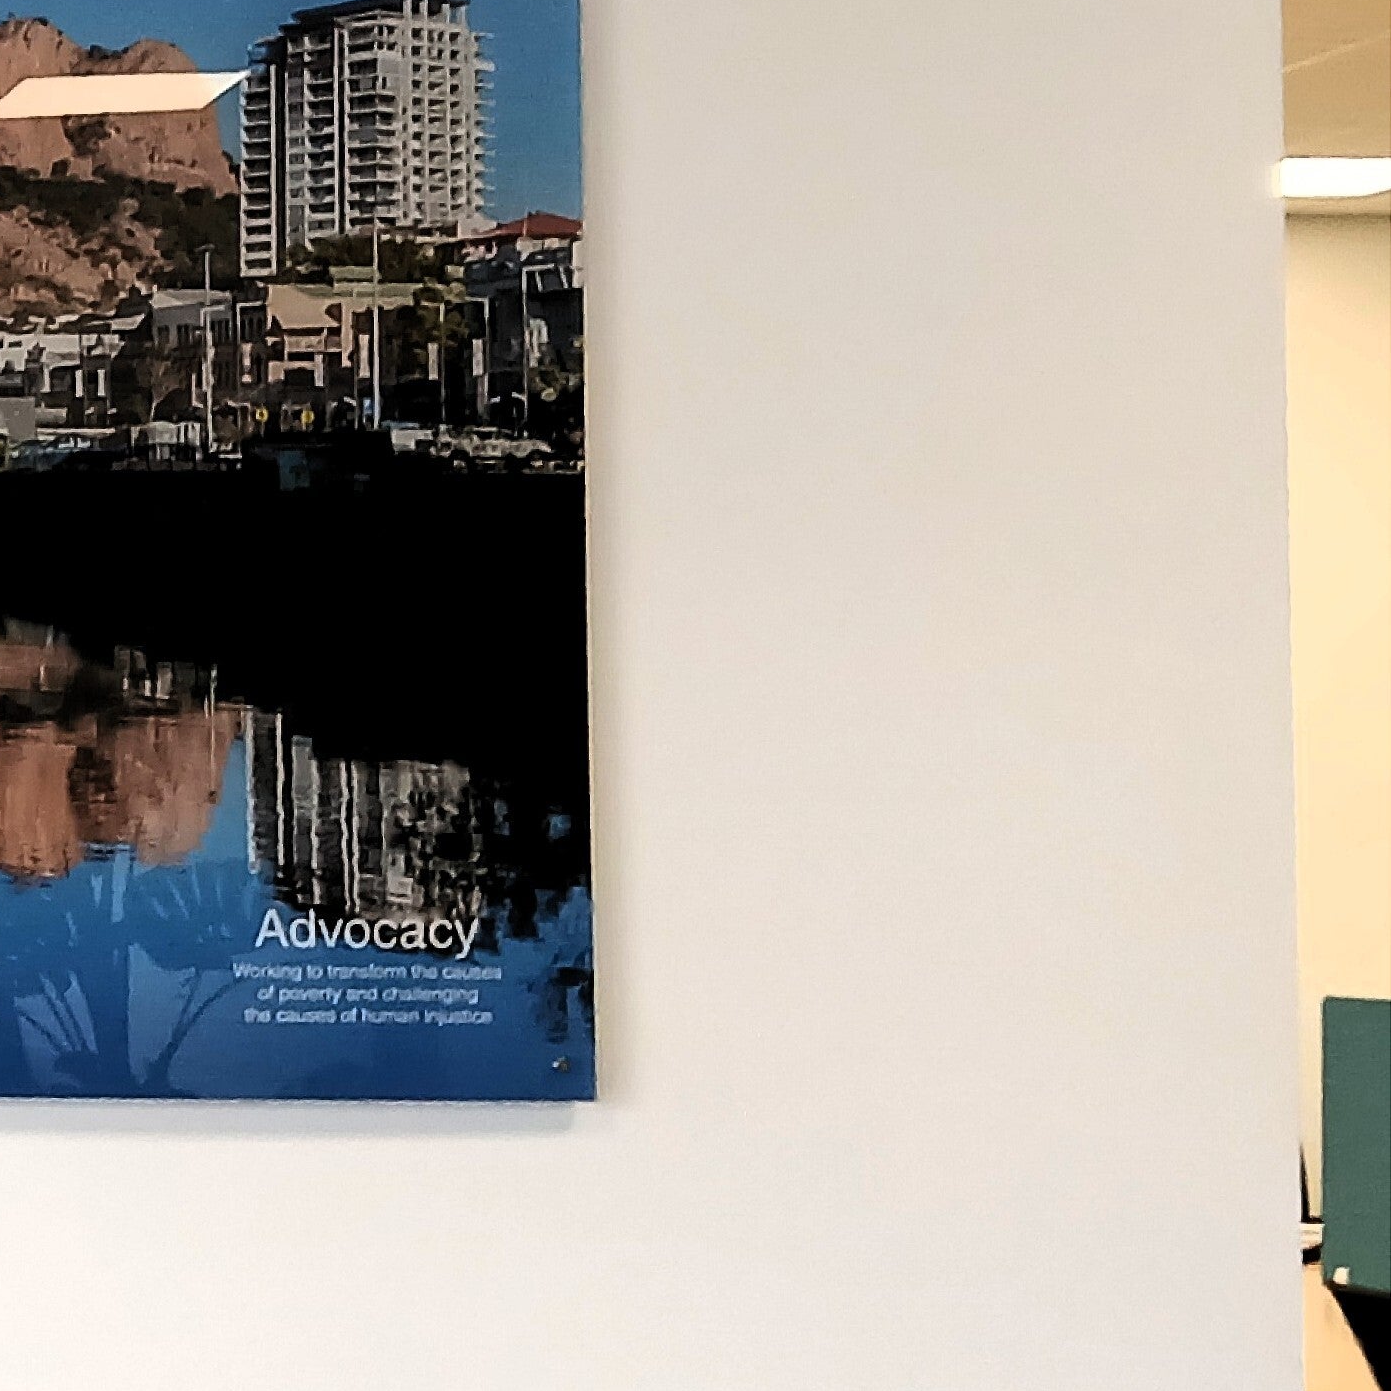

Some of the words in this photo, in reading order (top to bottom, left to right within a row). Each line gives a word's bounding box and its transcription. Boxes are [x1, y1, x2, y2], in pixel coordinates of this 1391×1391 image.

[255, 908, 479, 959] Advocacy
[232, 963, 302, 982] Working
[306, 965, 323, 980] to
[327, 964, 407, 980] transform
[411, 964, 438, 980] the
[441, 965, 502, 980] causes
[256, 985, 274, 1001] of
[278, 987, 343, 1004] poverty
[346, 985, 378, 1001] and
[381, 985, 479, 1004] challenging
[243, 1008, 271, 1024] the
[275, 1009, 338, 1024] causes
[340, 1007, 358, 1024] of
[362, 1008, 420, 1024] human
